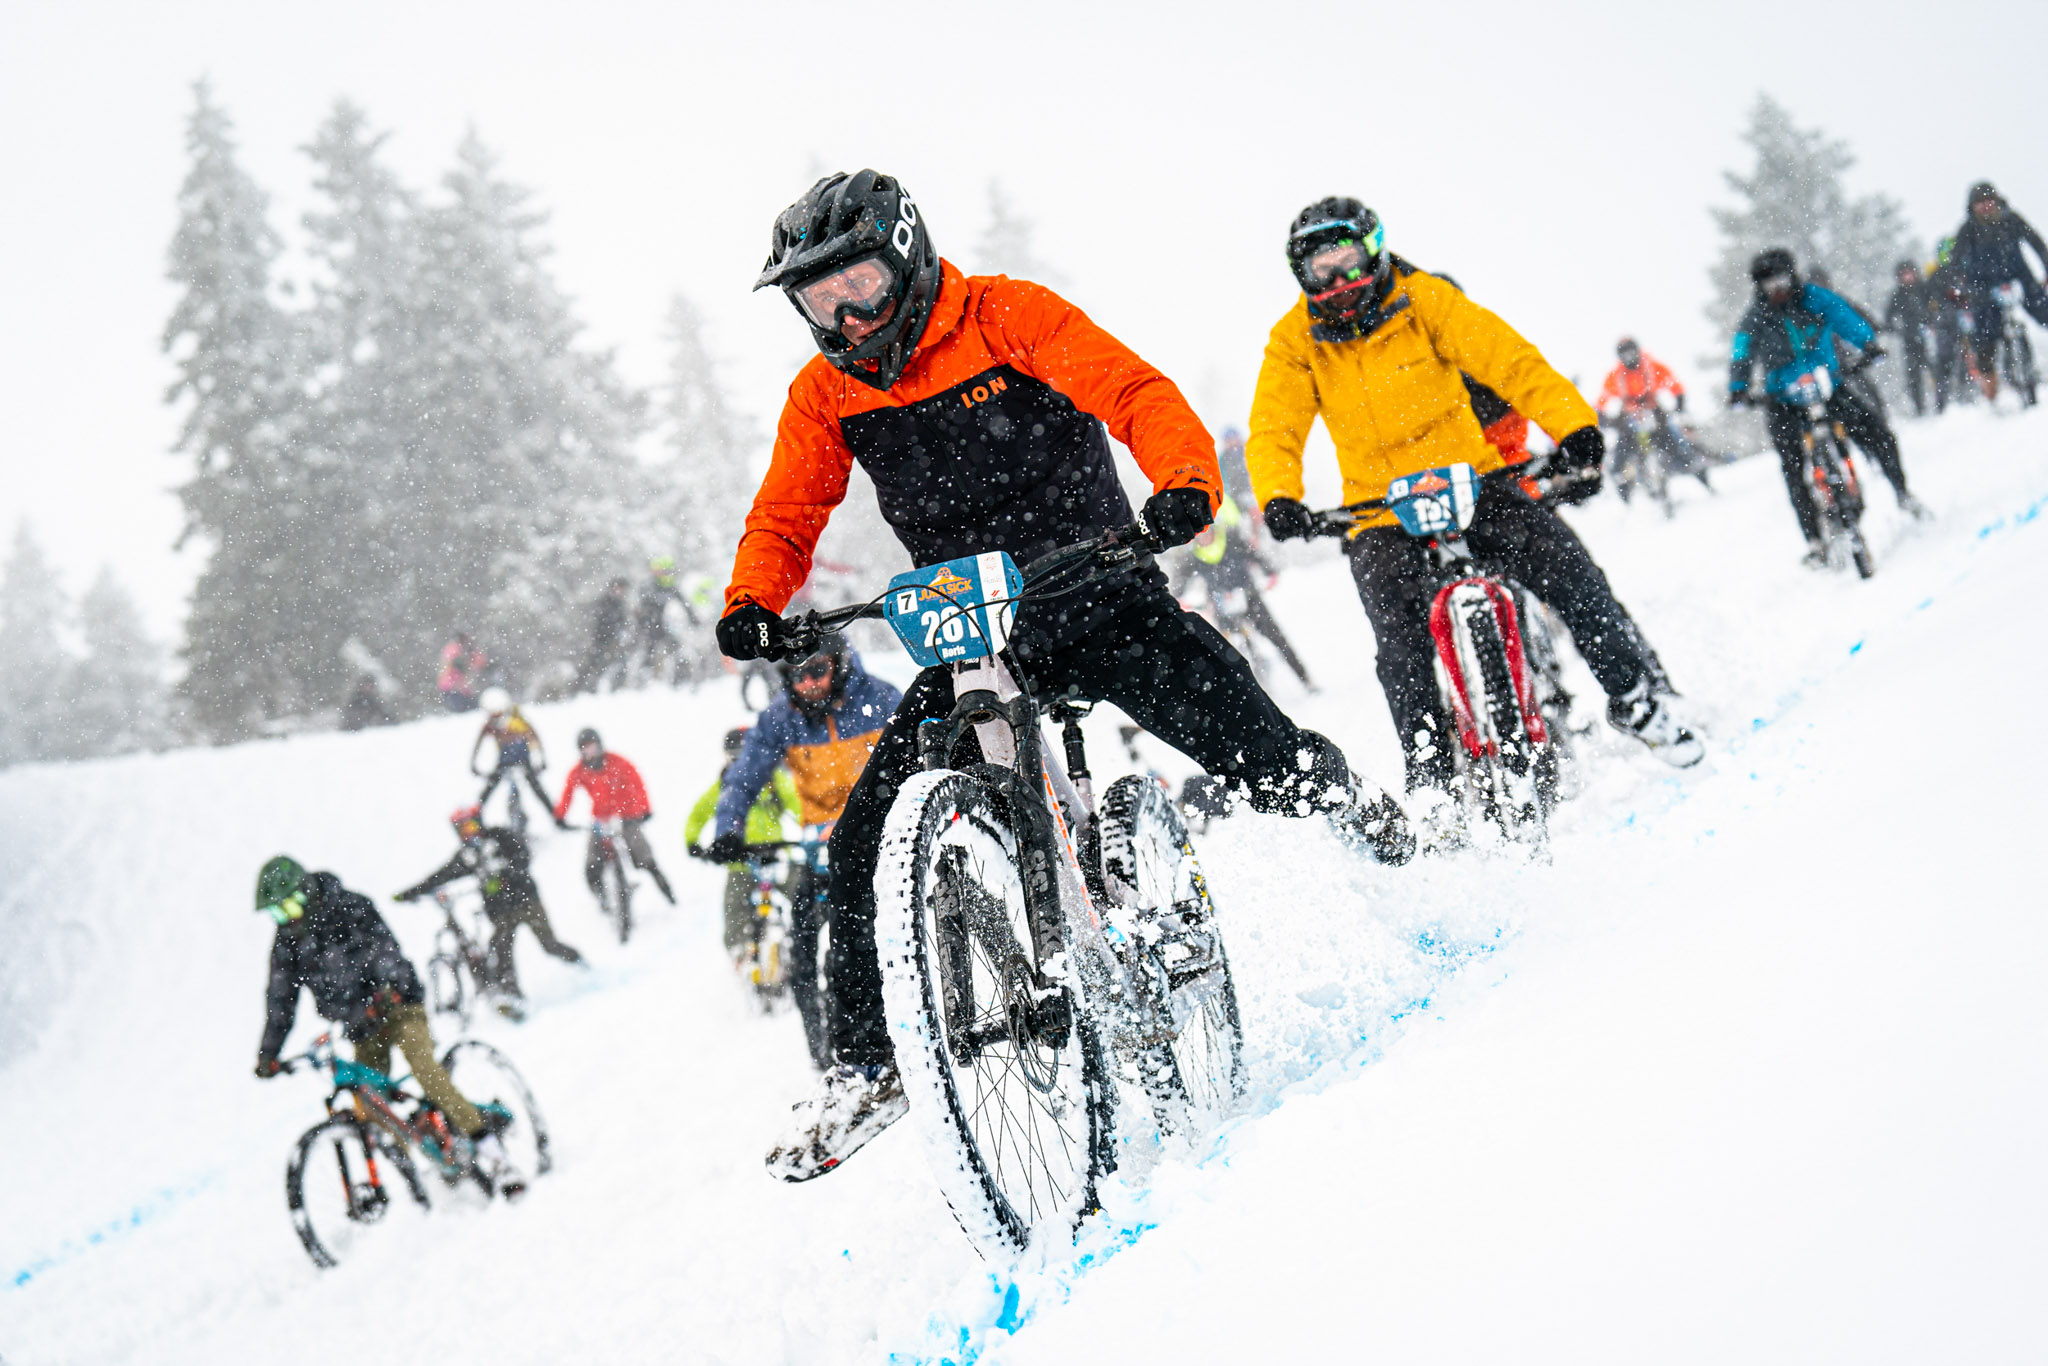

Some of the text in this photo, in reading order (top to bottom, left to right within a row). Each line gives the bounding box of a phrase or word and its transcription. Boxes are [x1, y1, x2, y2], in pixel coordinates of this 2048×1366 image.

[961, 376, 1008, 409] ION
[900, 593, 912, 611] 7
[921, 602, 981, 648] 261
